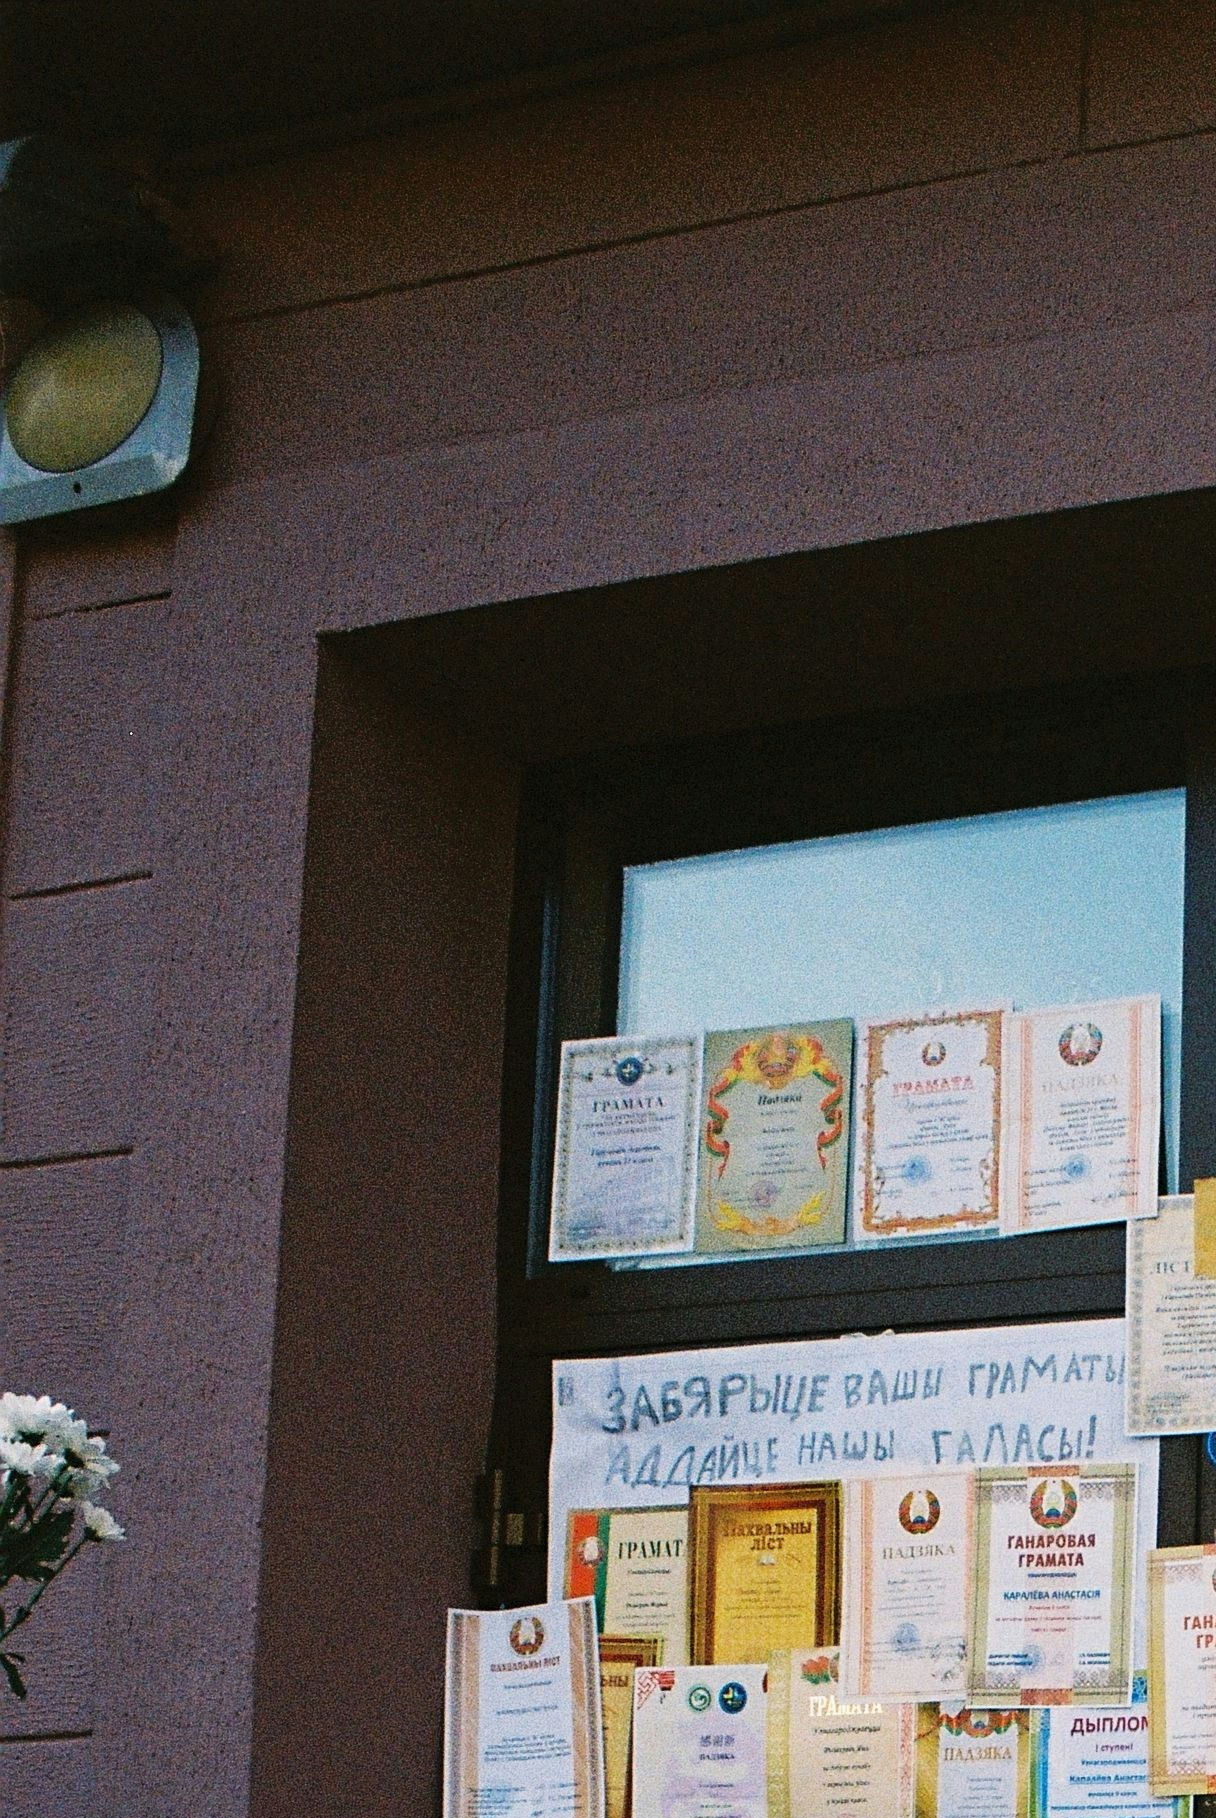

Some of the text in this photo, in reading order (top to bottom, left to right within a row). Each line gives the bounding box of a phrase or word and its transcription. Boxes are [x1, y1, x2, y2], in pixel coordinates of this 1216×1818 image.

[592, 1096, 665, 1113] ГРАМАТА
[601, 1353, 1127, 1435] ЗАБЯРЫЦЕ ВАШЫ ГРАМАТЫ
[605, 1415, 1097, 1491] АДДАЙЦЕ НАШЫ ГАЛАСЫ!
[617, 1539, 684, 1560] ГРАМАТ
[1007, 1533, 1096, 1550] ГАНАРОВАЯ
[882, 1543, 956, 1561] ПАДЗЯКА
[1018, 1553, 1084, 1568] ГРАМАТА
[1003, 1588, 1101, 1601] КАРАЛЁВА АНАСТАСІЯ
[943, 1745, 1012, 1762] ПАДЗЯКА
